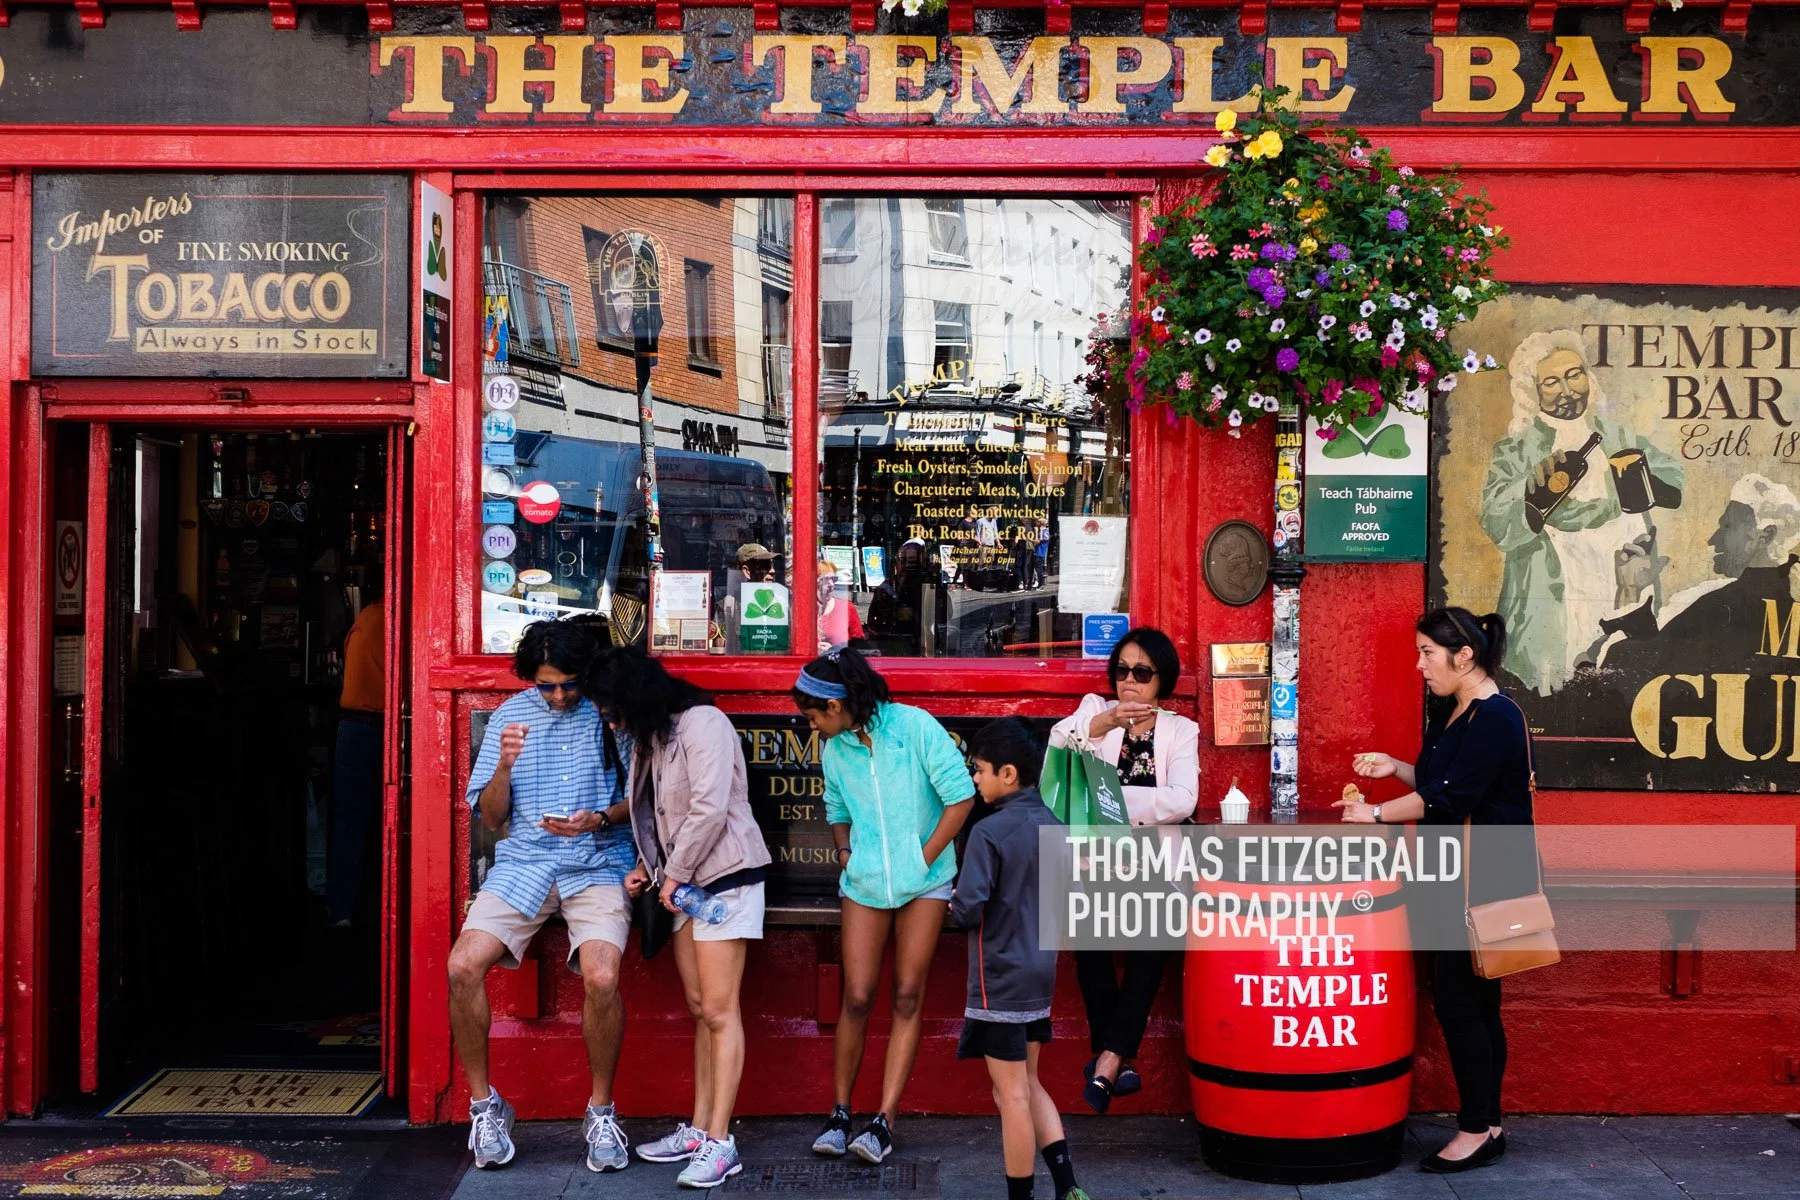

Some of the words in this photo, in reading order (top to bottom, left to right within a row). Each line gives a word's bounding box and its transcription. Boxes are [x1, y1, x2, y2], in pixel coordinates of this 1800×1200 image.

[374, 35, 690, 120] THE
[742, 35, 1356, 120] TEMPLE
[1422, 35, 1737, 121] BAR
[47, 192, 193, 251] Importers
[138, 229, 165, 245] OF
[177, 242, 233, 262] FINE
[238, 241, 350, 262] SMOKING
[86, 253, 351, 342] TOBACCO
[140, 328, 240, 351] Always
[256, 331, 279, 349] in
[293, 328, 373, 350] Stock
[1581, 323, 1800, 369] TEMPL
[1662, 375, 1793, 428] BAR
[1031, 412, 1067, 427] Fare
[895, 437, 928, 452] Meat
[1680, 424, 1751, 460] Estb.
[877, 459, 914, 475] Fresh
[918, 459, 971, 478] Oysters,
[976, 459, 1028, 475] Smoked
[1033, 459, 1083, 475] Salmon
[894, 481, 973, 497] Charcuterie
[978, 481, 1021, 499] Meats,
[1025, 481, 1066, 497] Olives
[1319, 487, 1353, 499] Teach
[1356, 487, 1414, 499] Tábhairne
[913, 503, 965, 518] Toasted
[970, 503, 1046, 518] Sandwiches
[1355, 503, 1377, 515] Pub
[908, 525, 935, 540] Hot
[940, 525, 977, 540] Roast
[1017, 525, 1050, 540] Rolls
[1351, 522, 1381, 531] FAOFA
[489, 536, 510, 547] PPI
[1341, 532, 1390, 541] APPROVED
[489, 572, 510, 583] PPI
[531, 608, 555, 617] free
[779, 804, 818, 820] EST.
[1269, 933, 1355, 967] THE
[1234, 972, 1389, 1008] TEMPLE
[1272, 1014, 1359, 1048] BAR
[158, 1085, 365, 1097] TEMPLE
[194, 1097, 298, 1108] BAR
